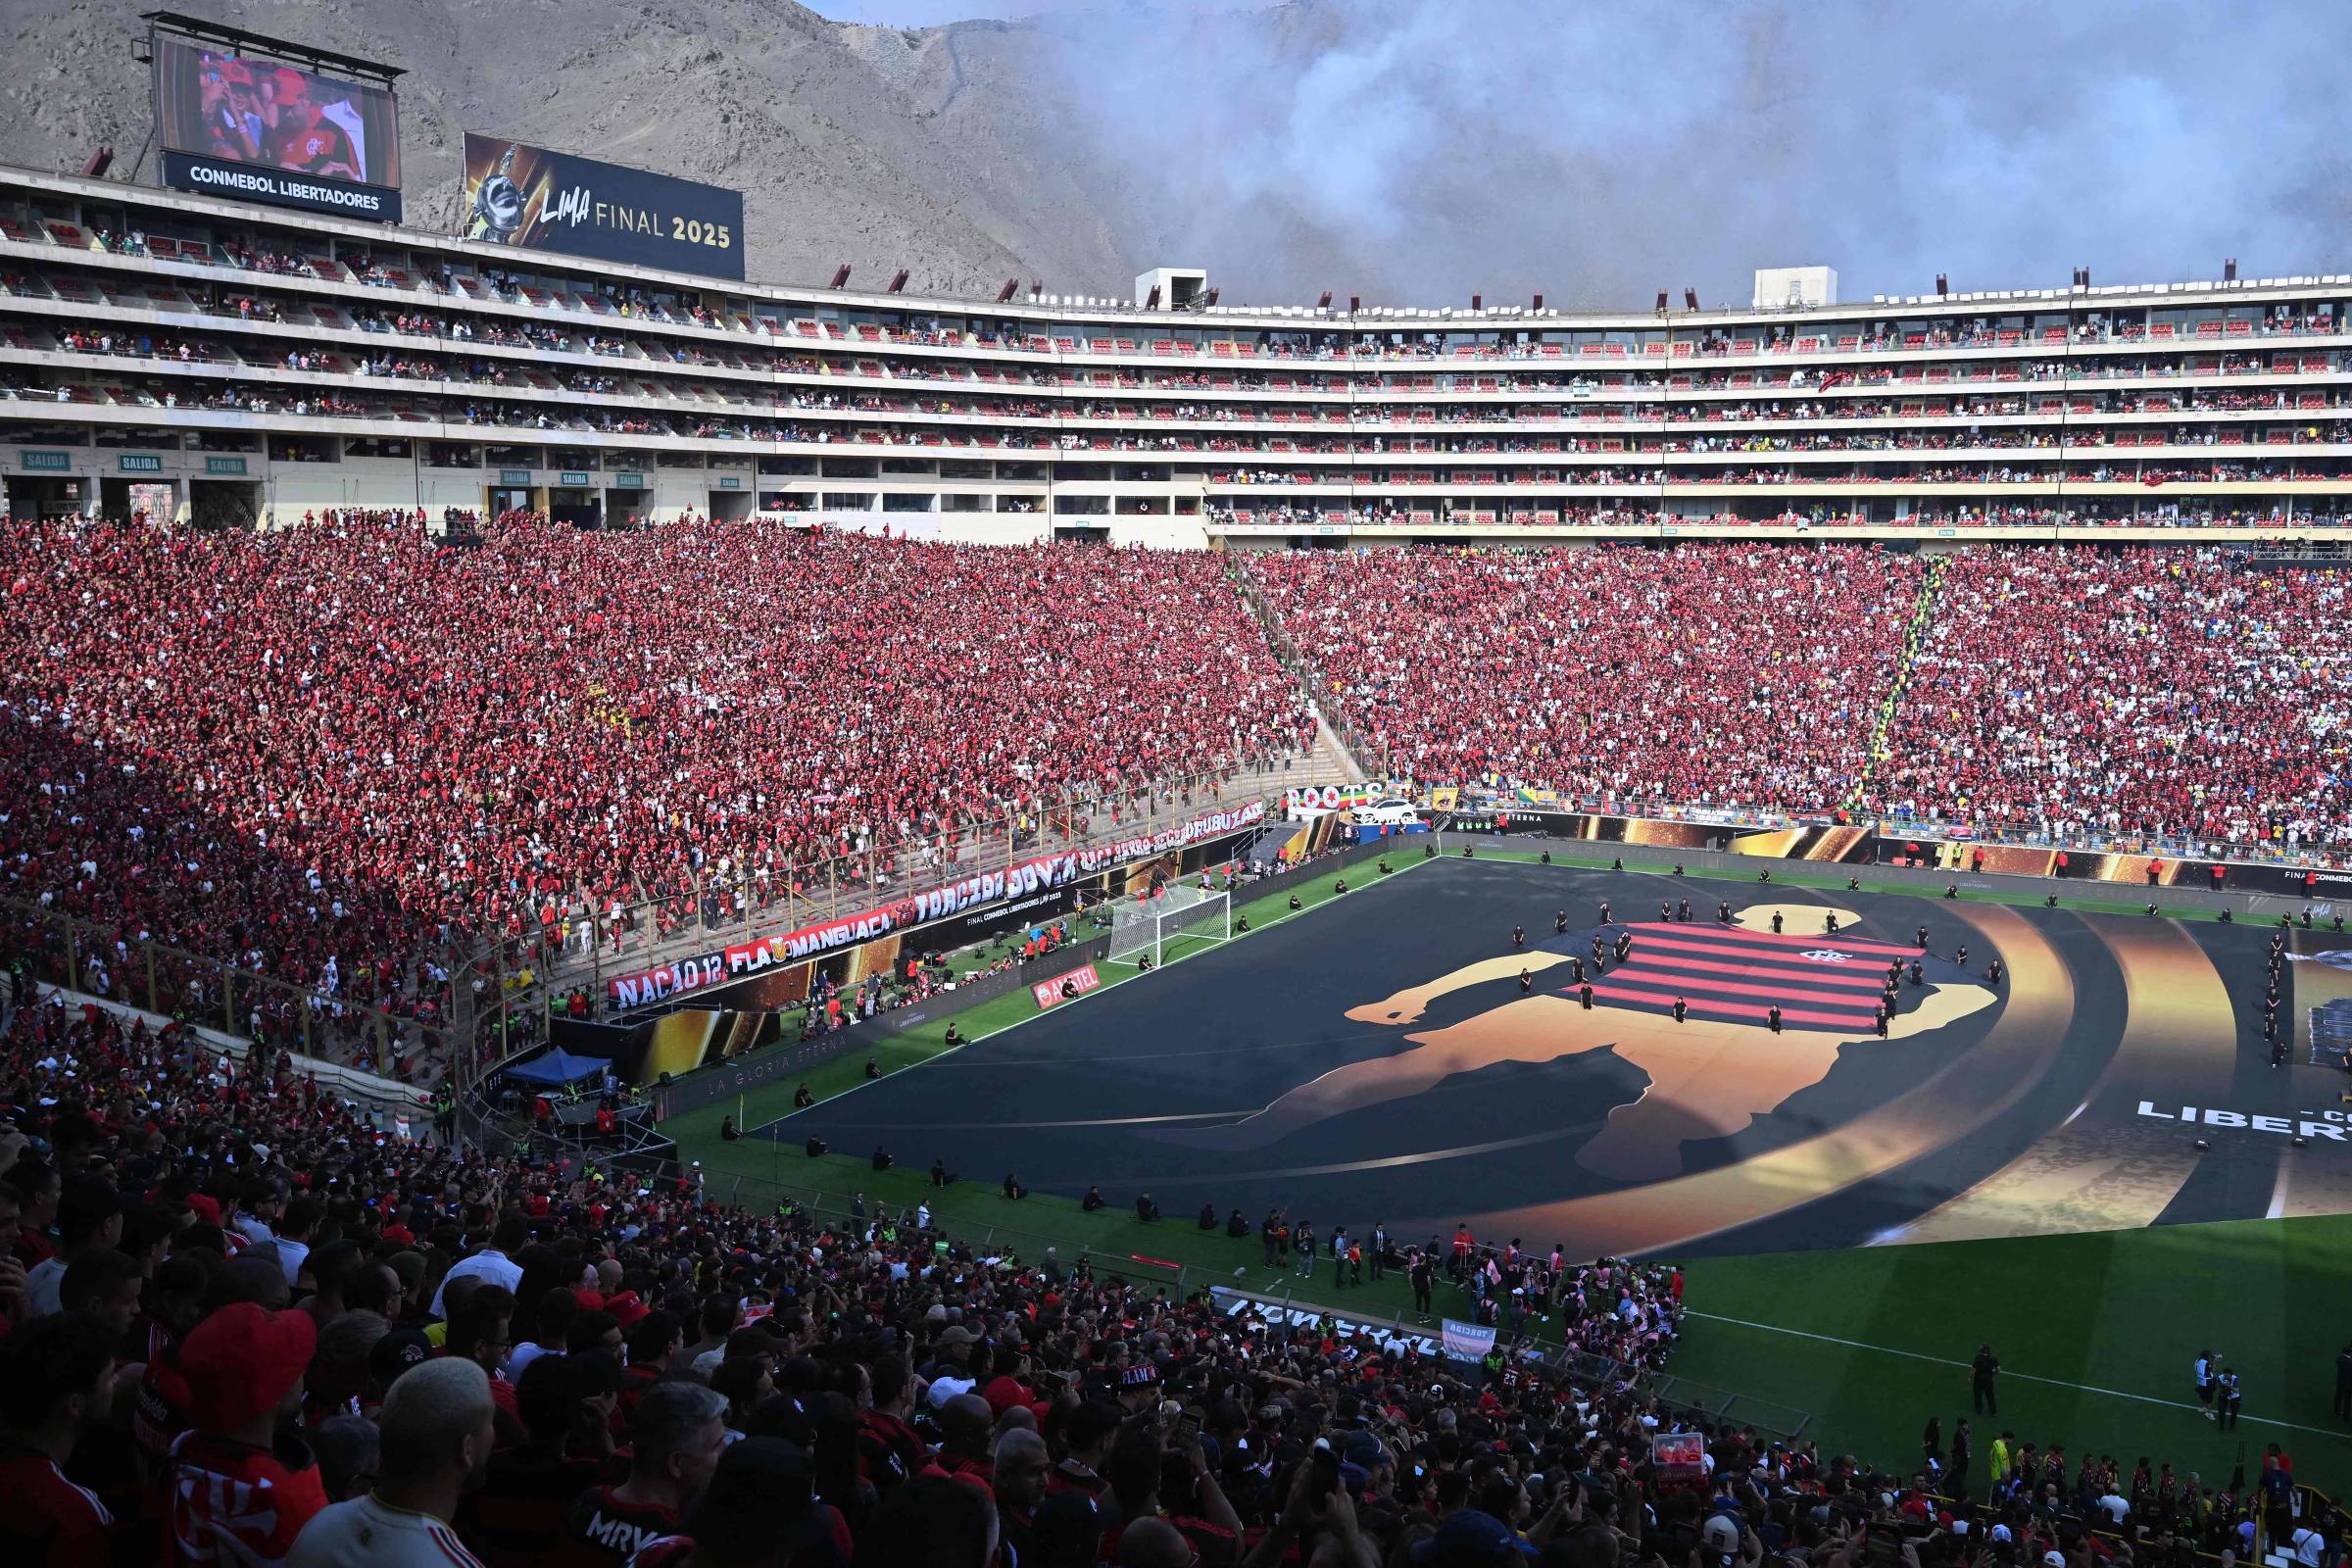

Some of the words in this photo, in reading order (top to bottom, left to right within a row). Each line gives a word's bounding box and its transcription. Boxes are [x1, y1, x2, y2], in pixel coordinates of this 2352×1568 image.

[190, 166, 277, 194] CONMEBOL
[279, 180, 380, 211] LIBERTADORES
[540, 185, 590, 227] LIMA
[596, 202, 664, 237] FINAL
[672, 217, 730, 248] 2025
[26, 454, 66, 467] SALIDA
[122, 458, 159, 470] SALIDA
[210, 460, 242, 472] SALIDA
[504, 471, 529, 483] SALIDA
[563, 473, 587, 485] SALIDA
[619, 475, 642, 486] SALIDA
[1286, 783, 1383, 809] ROOTS
[1506, 813, 1543, 822] ETERNA
[2284, 871, 2307, 880] FINA
[966, 916, 984, 926] FINAL
[983, 907, 1009, 921] CONMEBOL
[1008, 898, 1040, 913] LIBERTADORES
[1049, 891, 1061, 902] 2025
[615, 959, 700, 1010] NAÇÃO
[703, 955, 723, 983] 12
[709, 1079, 727, 1095] LA
[735, 1056, 791, 1085] GLORIA
[798, 1034, 848, 1063] ETERNA
[2137, 1101, 2352, 1142] LIBER
[585, 1509, 660, 1553] MRV
